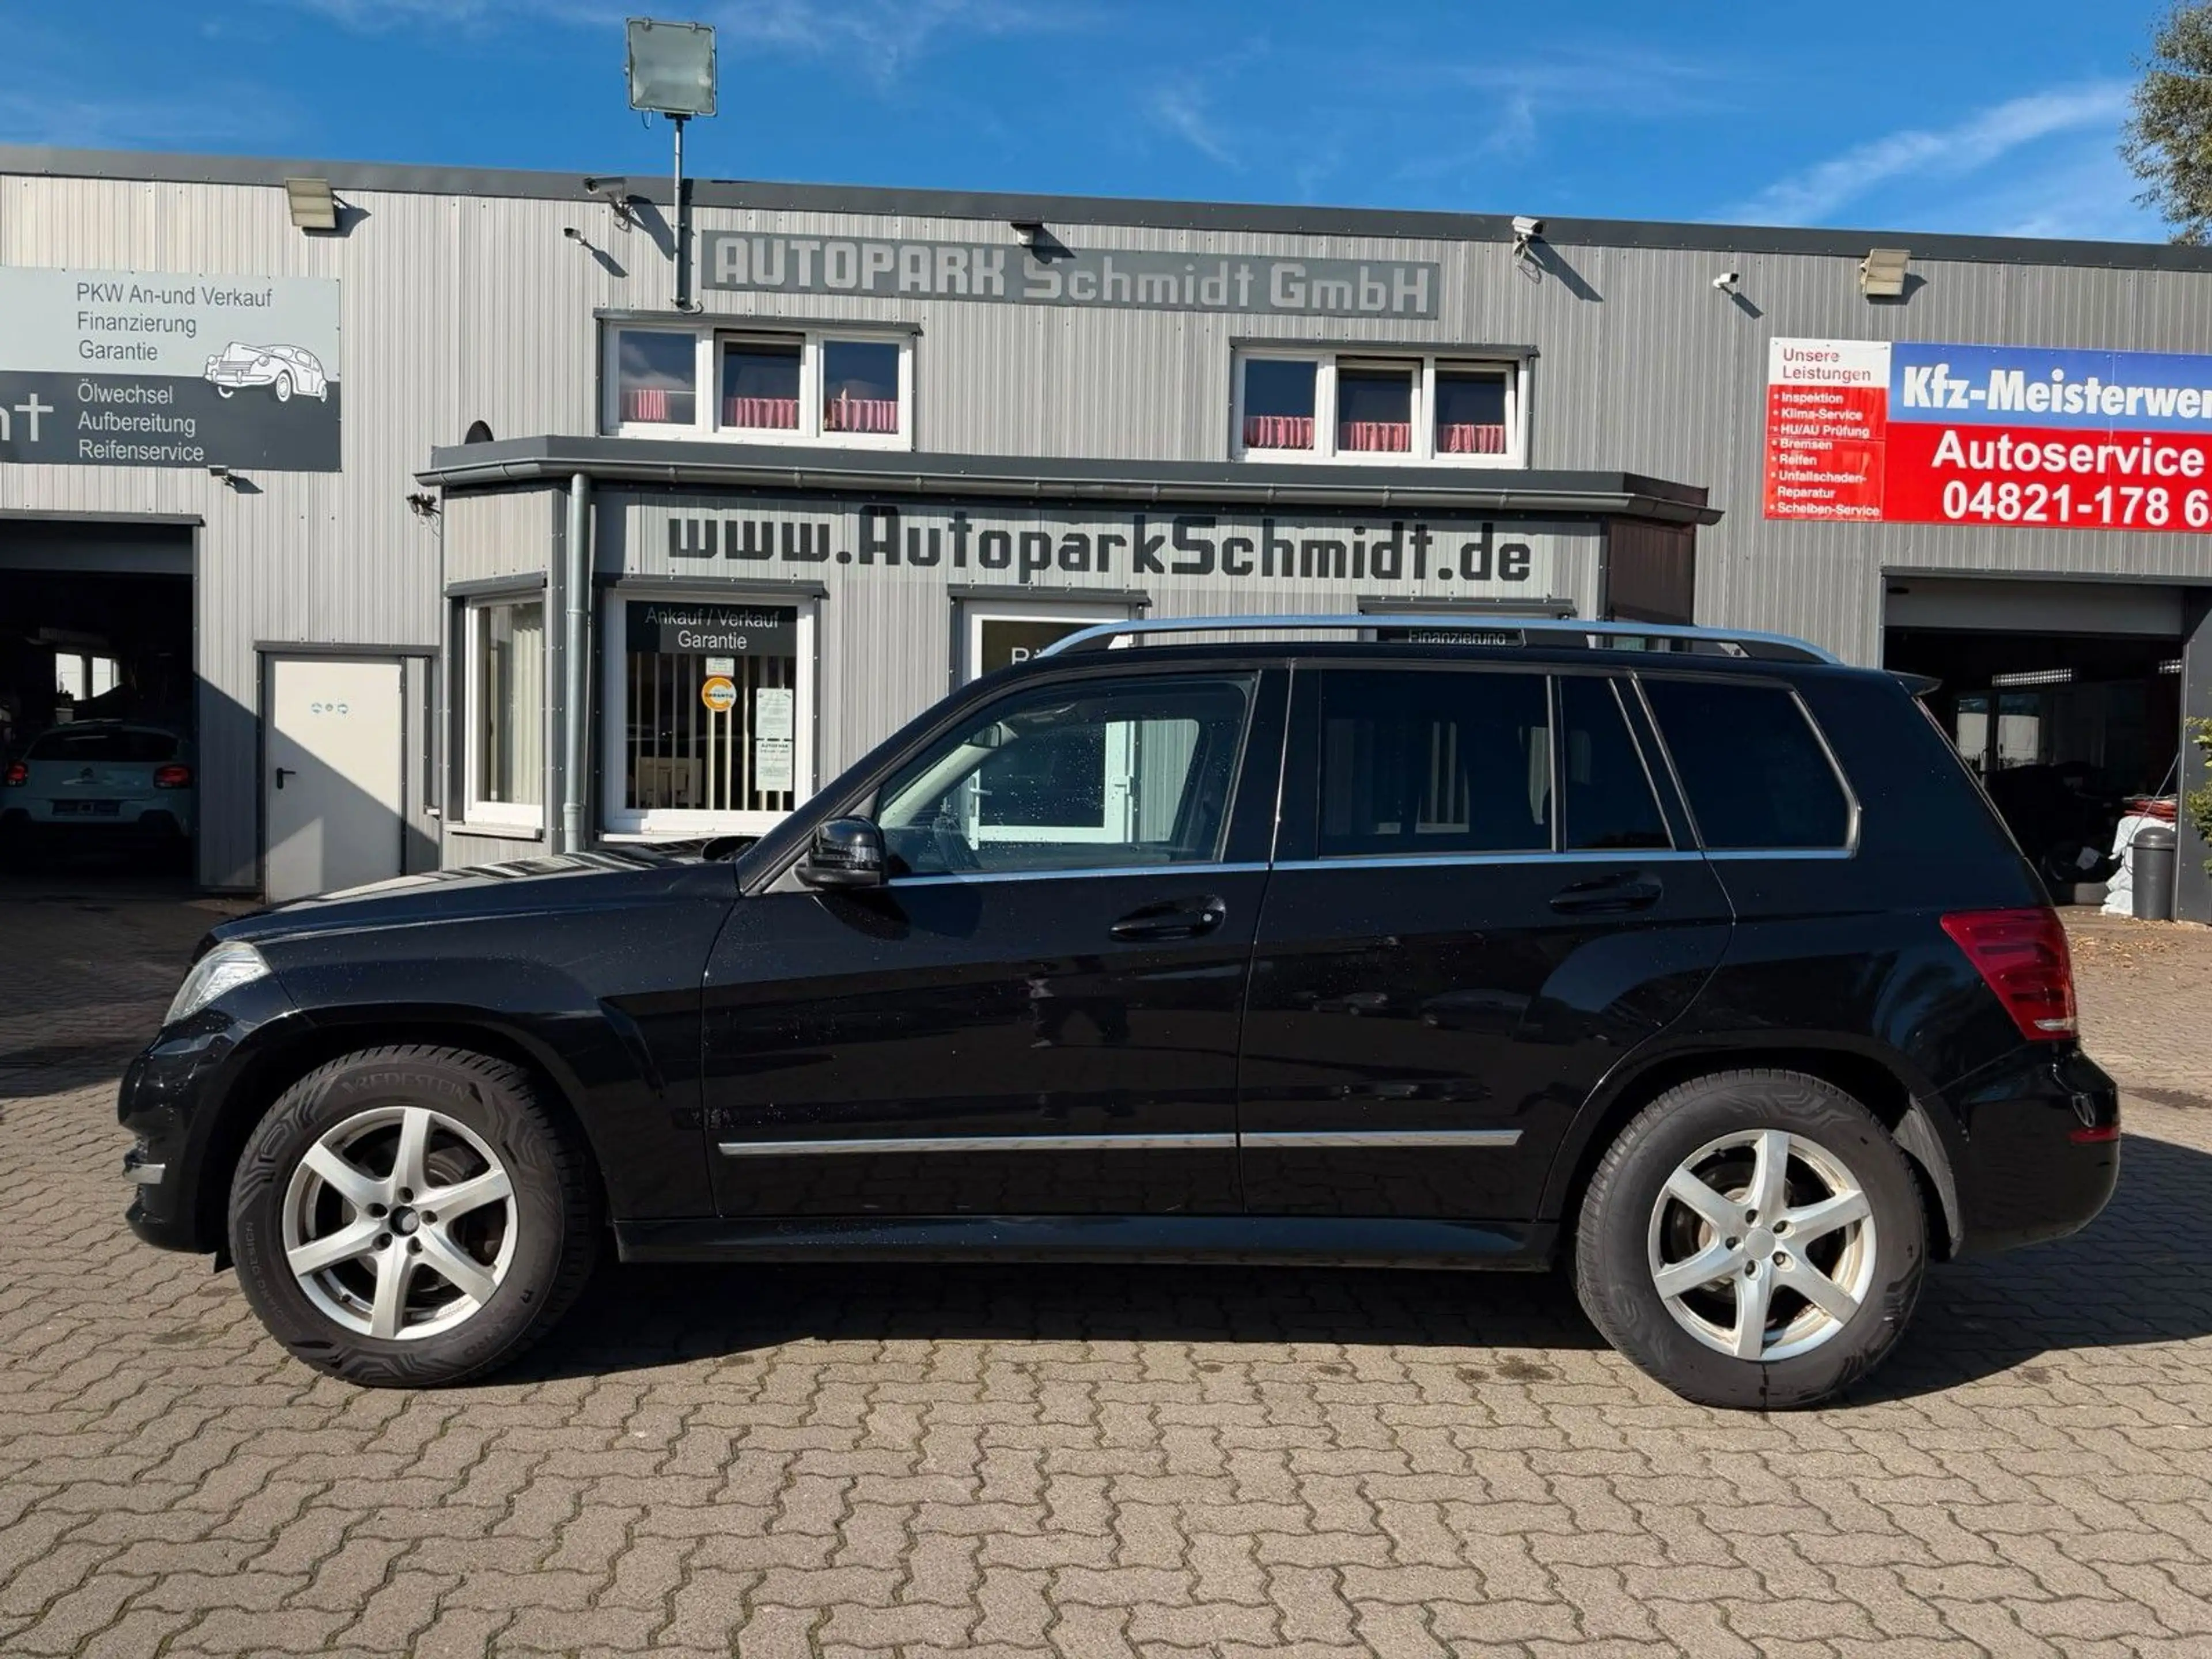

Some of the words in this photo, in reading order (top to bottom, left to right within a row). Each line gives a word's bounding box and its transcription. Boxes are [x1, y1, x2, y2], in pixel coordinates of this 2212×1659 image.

[715, 237, 1005, 296] AUTOPARK
[1023, 257, 1252, 307] Schmidt
[1269, 261, 1429, 314] GmbH
[76, 282, 123, 303] PKW
[128, 285, 195, 305] An-und
[202, 286, 272, 307] Verkauf
[77, 311, 196, 338] Finanzierung
[78, 340, 158, 361] Garantie
[1783, 348, 1840, 363] Unsere
[1782, 365, 1872, 384] Leistungen
[77, 378, 173, 404] Ölwechsel
[1781, 392, 1844, 404] Inspektion
[77, 411, 196, 438] Aufbereitung
[1781, 408, 1863, 421] Klima-Service
[1780, 424, 1820, 436] HU/AU
[1823, 425, 1870, 439] Prüfung
[78, 439, 204, 462] Reifenservice
[1779, 438, 1833, 450] Bremsen
[1931, 429, 2205, 478] Autoservice
[1779, 453, 1817, 465] Reifen
[1778, 471, 1867, 484] Unfallschaden-
[1777, 486, 1836, 499] Reparatur
[1777, 501, 1881, 517] Scheiben-Service
[1942, 480, 2169, 527] 04821-178
[2184, 488, 2212, 528] 6
[668, 505, 1531, 583] www.AutoparkSchmidt.de
[645, 606, 704, 626] Ankauf
[717, 609, 779, 628] Verkauf
[677, 630, 748, 650] Garantie
